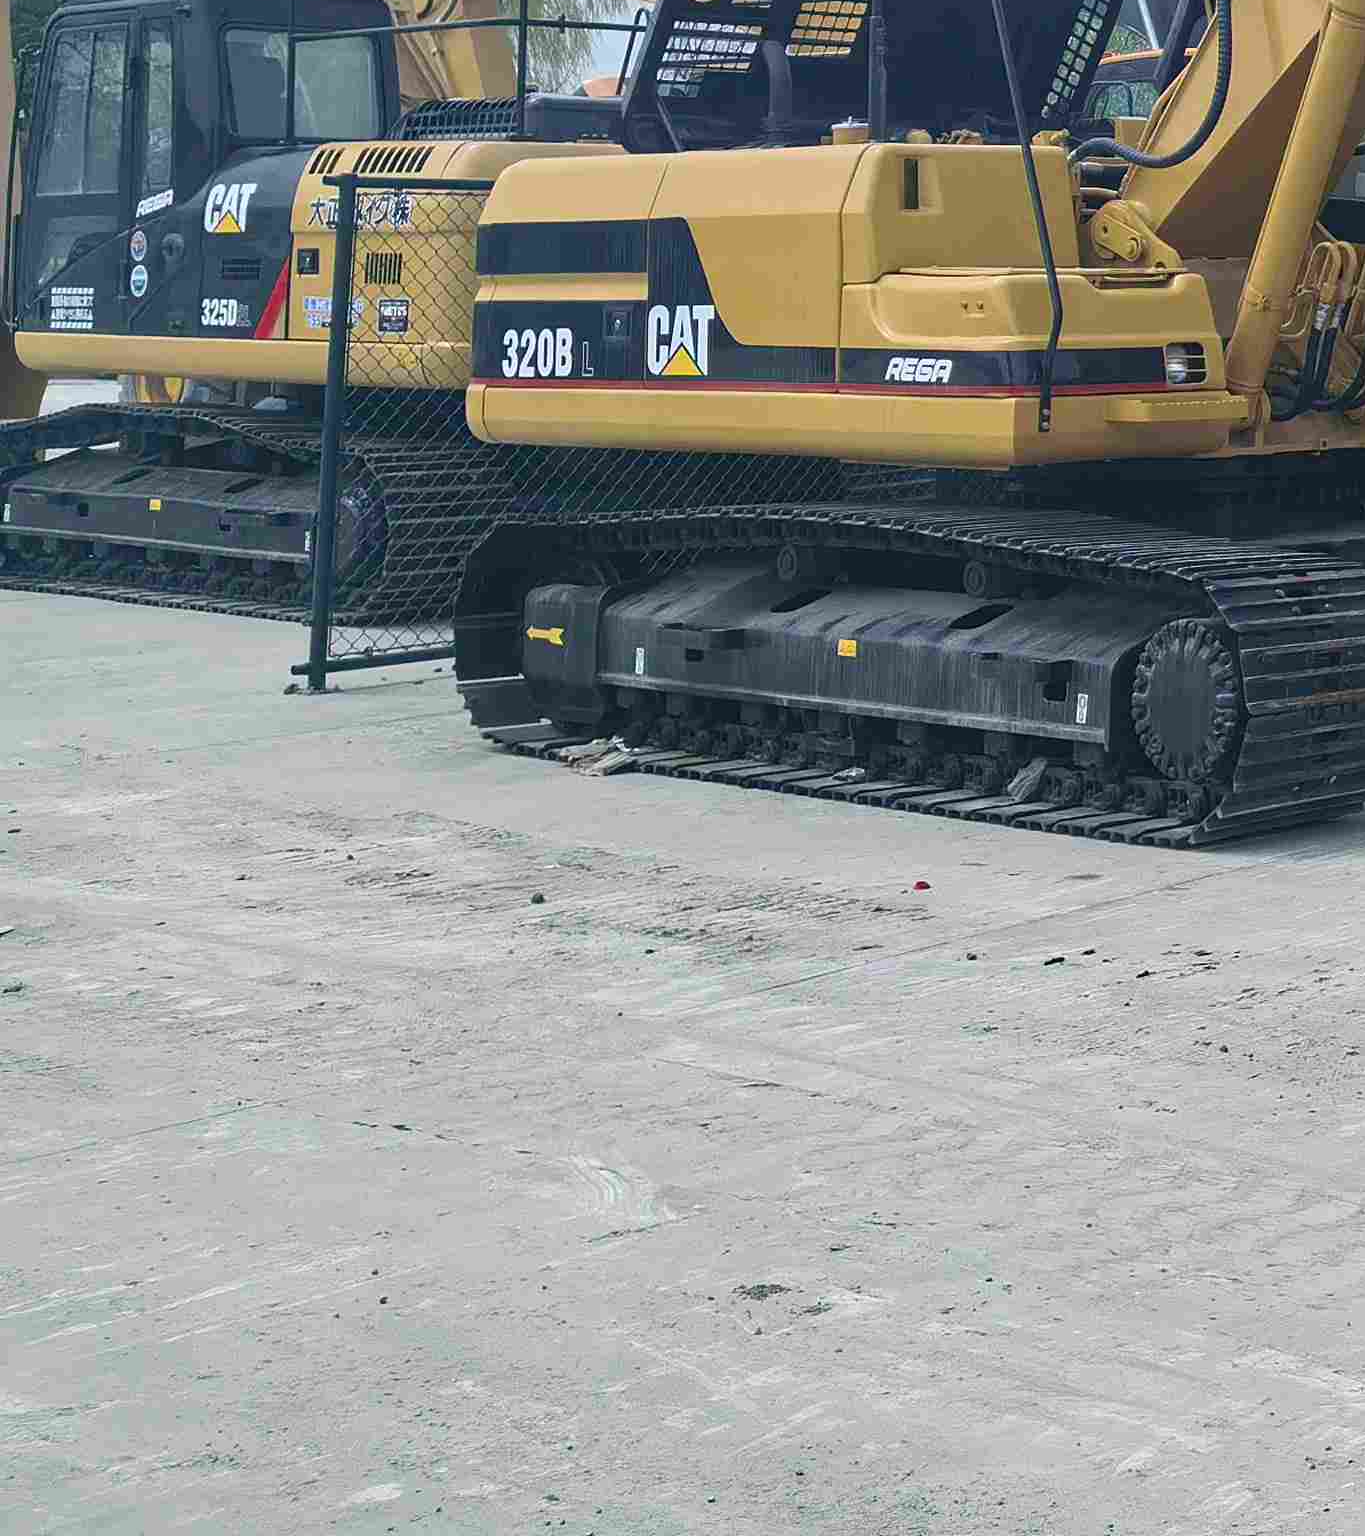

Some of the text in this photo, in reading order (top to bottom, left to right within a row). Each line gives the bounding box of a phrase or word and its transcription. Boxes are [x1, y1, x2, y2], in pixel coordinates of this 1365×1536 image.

[204, 183, 258, 233] CAT
[200, 298, 238, 327] 325D
[502, 328, 594, 378] 320B L
[647, 305, 715, 376] CAT
